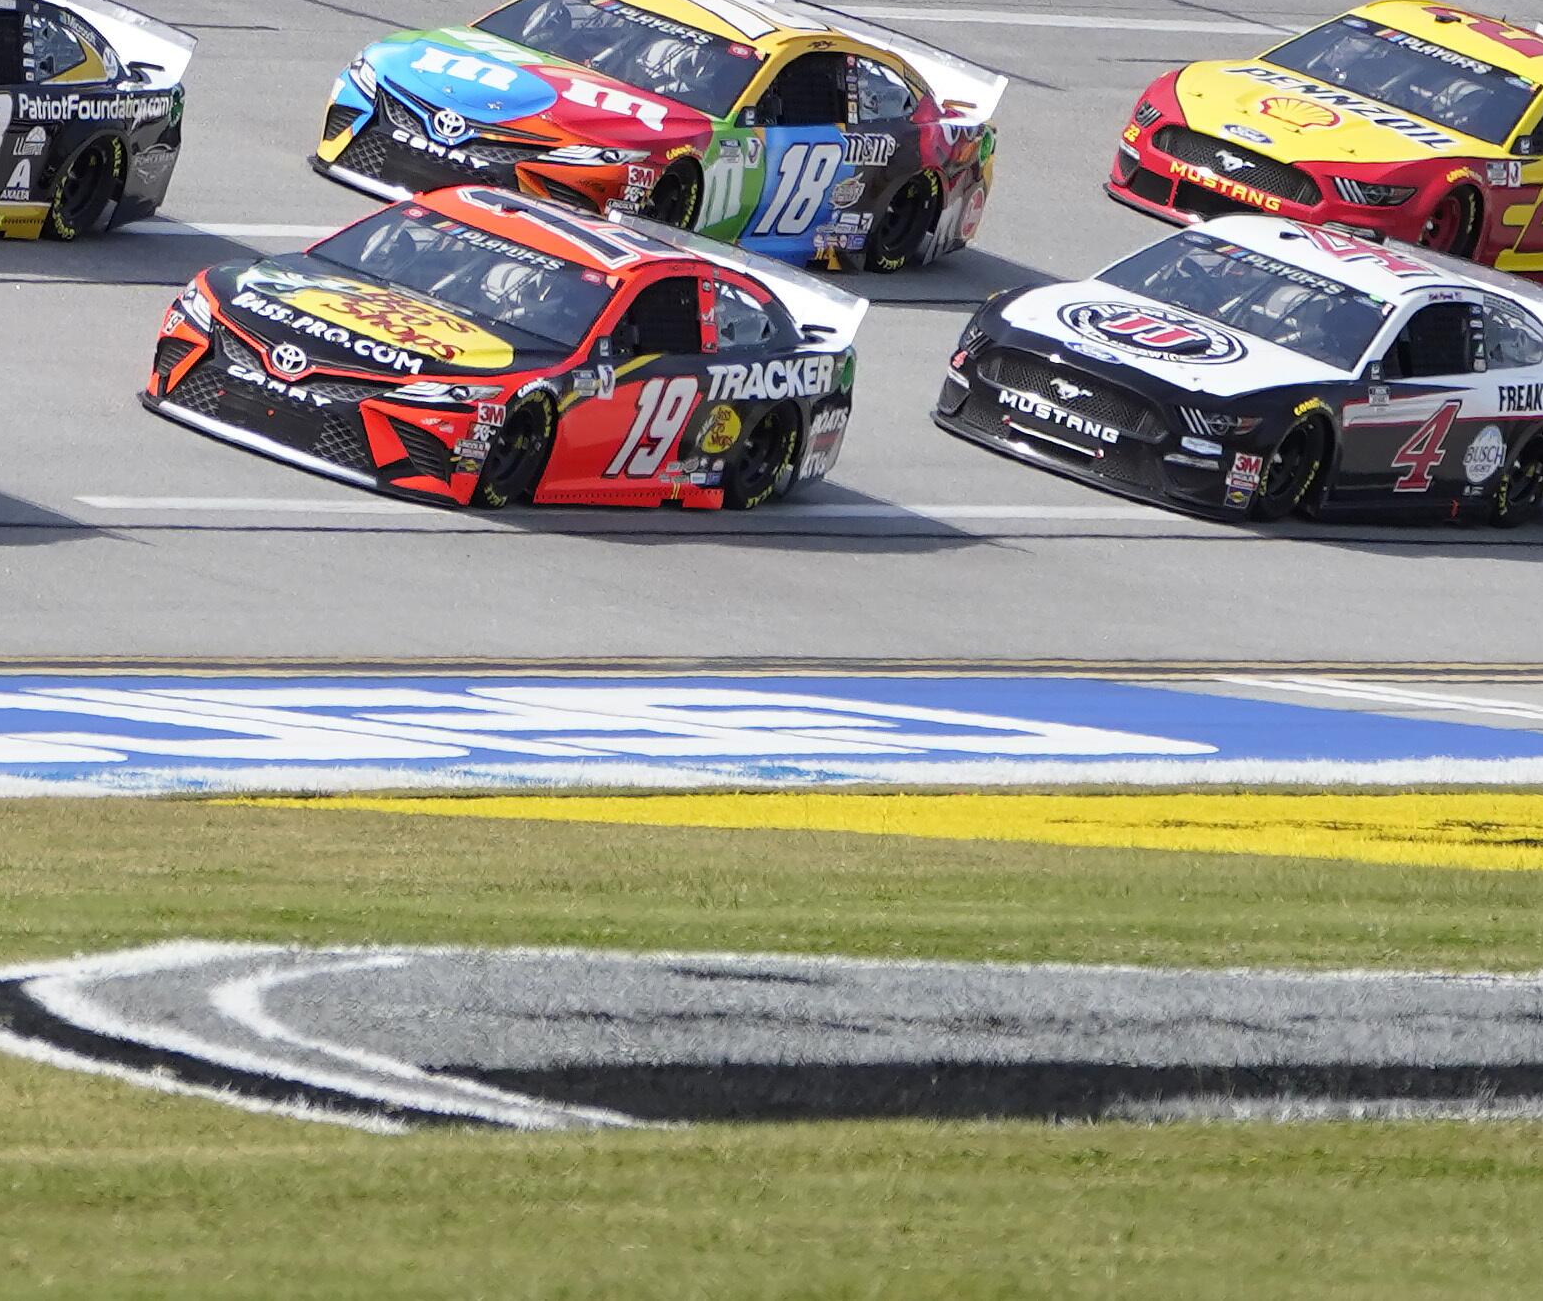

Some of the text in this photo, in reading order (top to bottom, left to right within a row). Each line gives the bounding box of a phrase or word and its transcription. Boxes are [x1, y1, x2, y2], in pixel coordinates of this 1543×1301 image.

[614, 6, 714, 45] PLAYOFFS
[1399, 37, 1493, 74] PLAYOFFS
[18, 92, 170, 122] PatriotFoundation.com
[1226, 66, 1458, 149] PENNZOIL
[392, 129, 490, 169] CAMRY
[629, 167, 655, 187] 3M
[751, 142, 842, 237] 18
[1170, 161, 1282, 211] MUSTANG
[457, 226, 567, 272] PLAYOFFS
[1243, 253, 1346, 296] PLAYOFFS
[315, 303, 466, 361] Shops
[227, 364, 333, 407] CAMRY
[707, 355, 836, 401] TRACKER
[479, 405, 505, 426] 3M
[605, 374, 700, 479] 19
[998, 390, 1120, 445] MUSTANG
[1235, 455, 1261, 474] 3M
[1391, 398, 1463, 492] 4
[1463, 445, 1507, 467] BUSCH
